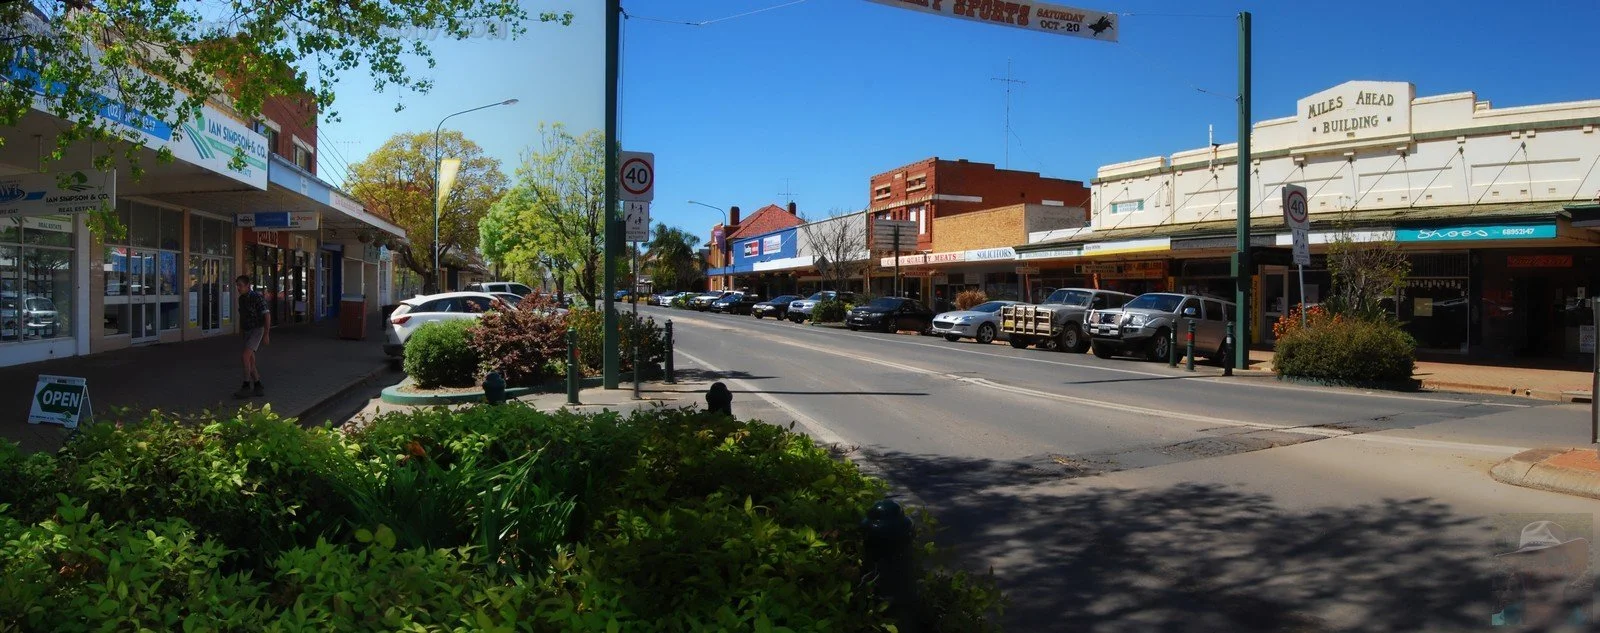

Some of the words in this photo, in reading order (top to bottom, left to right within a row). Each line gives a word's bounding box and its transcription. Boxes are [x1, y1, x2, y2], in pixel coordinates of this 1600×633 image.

[953, 0, 1030, 26] SPORTS
[1036, 7, 1085, 23] SATURDAY
[1308, 96, 1343, 119] MILES
[1356, 90, 1394, 106] AHEAD
[1322, 115, 1379, 133] BUILDING
[208, 119, 222, 137] IAN
[223, 126, 250, 150] SIMPSON
[256, 144, 267, 159] CO.
[625, 167, 648, 185] 40
[59, 194, 89, 203] SIMPSON
[74, 205, 96, 213] ESTATE
[1291, 199, 1305, 215] 40
[1418, 229, 1488, 239] Shoes
[934, 252, 957, 262] MEATS
[976, 248, 1012, 259] SOLICITORS
[42, 389, 80, 407] OPEN
